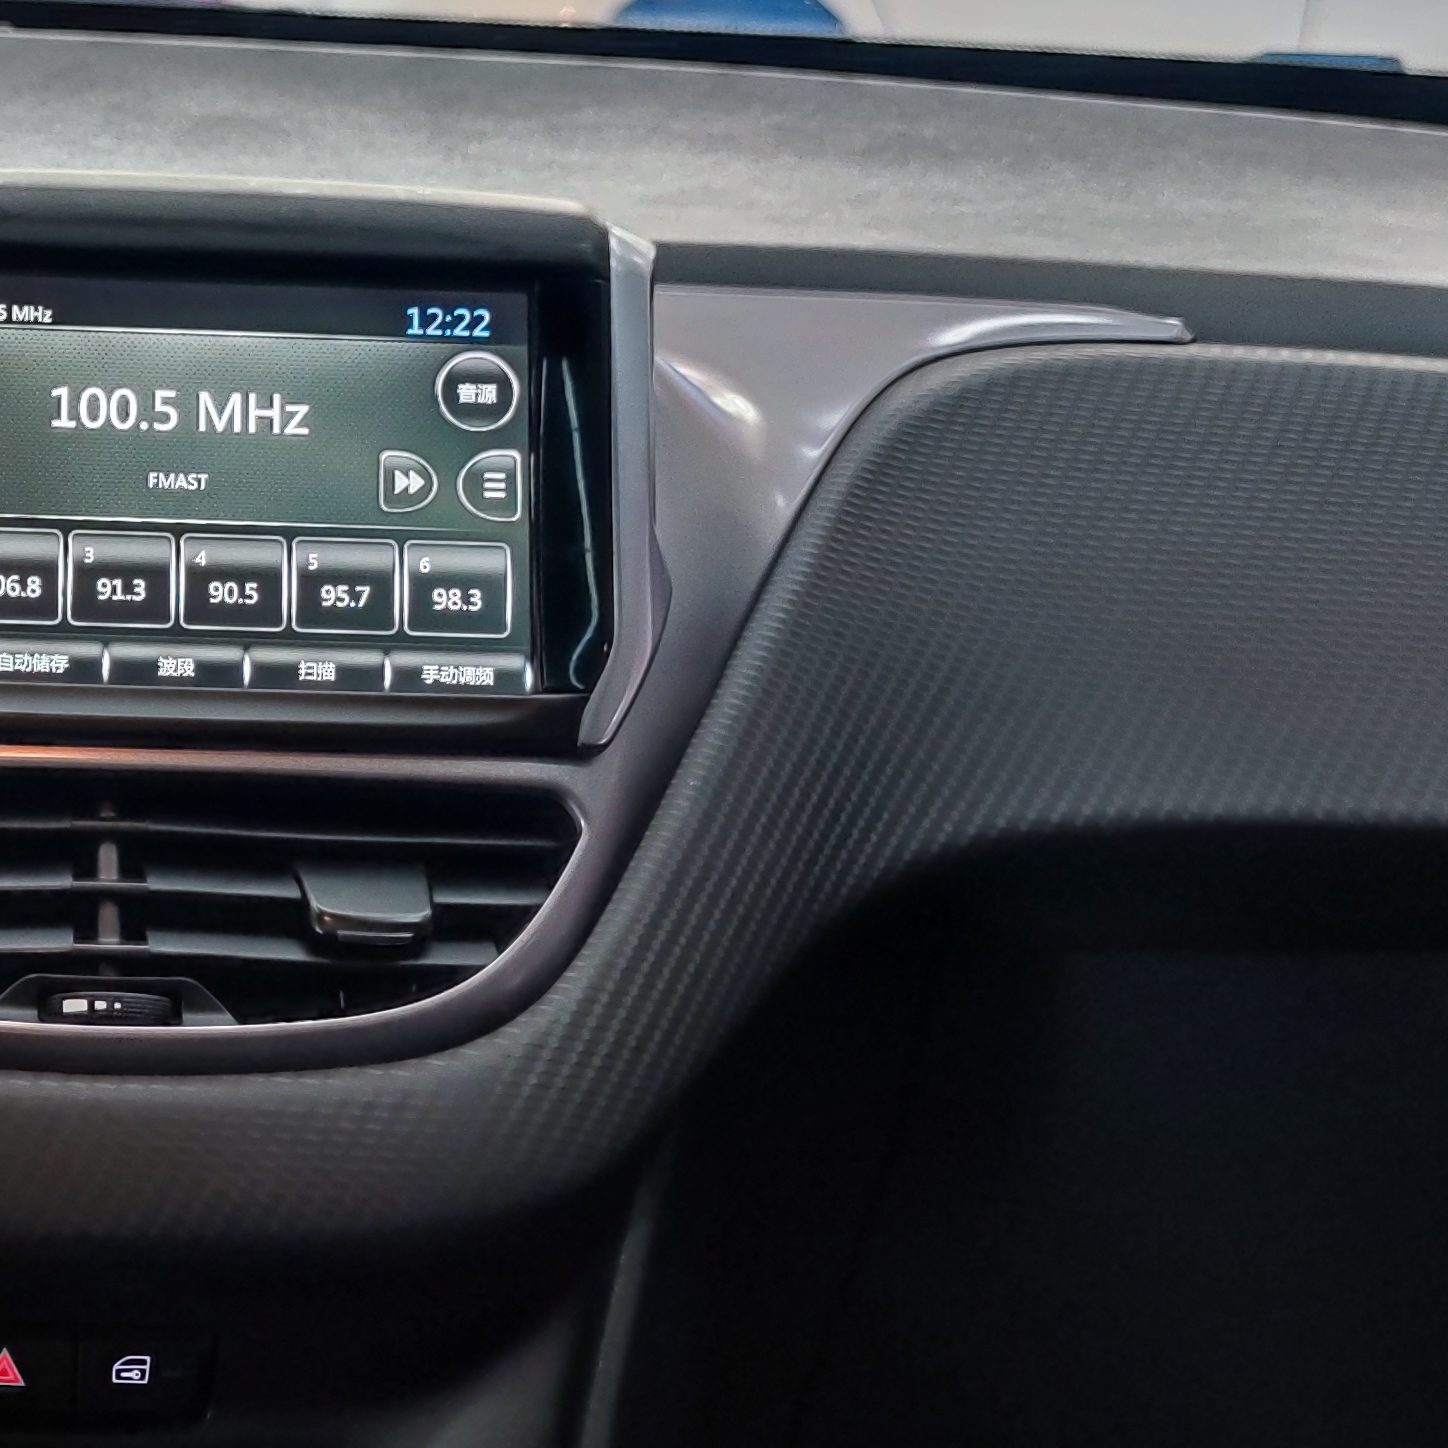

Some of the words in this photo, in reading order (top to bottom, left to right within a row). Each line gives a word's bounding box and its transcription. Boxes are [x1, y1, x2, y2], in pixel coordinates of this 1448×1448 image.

[12, 305, 53, 323] MHz
[406, 307, 491, 337] 12:22
[457, 383, 497, 404] 音源
[50, 385, 179, 432] 100.5
[197, 390, 310, 435] MHz
[147, 471, 209, 490] FMAST
[83, 547, 95, 564] 3
[192, 550, 206, 566] 4
[307, 554, 319, 570] 5
[418, 557, 431, 573] 6
[96, 578, 146, 601] 91.3
[208, 581, 259, 605] 90.5
[320, 585, 371, 609] 95.7
[432, 588, 483, 612] 98.3
[157, 657, 195, 678] 波段
[298, 660, 336, 682] 扫描
[421, 665, 494, 687] 手动调频
